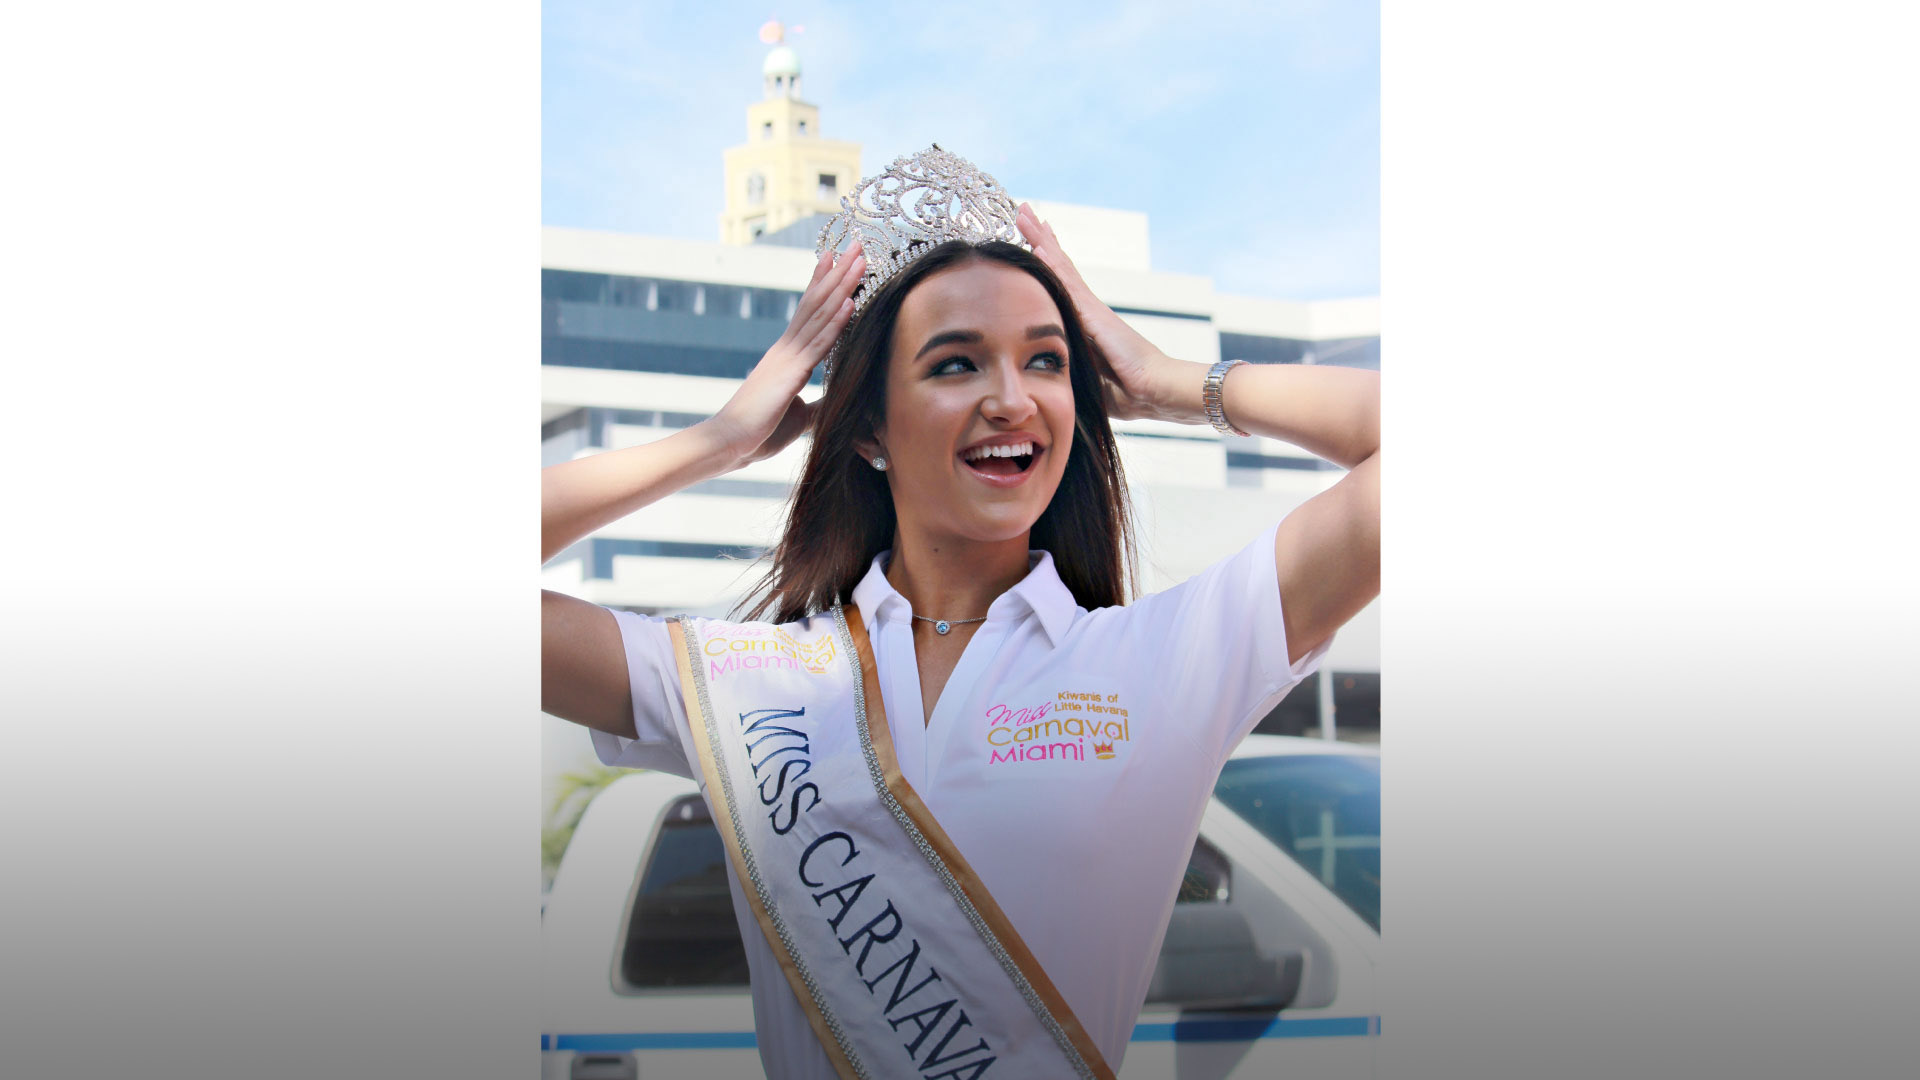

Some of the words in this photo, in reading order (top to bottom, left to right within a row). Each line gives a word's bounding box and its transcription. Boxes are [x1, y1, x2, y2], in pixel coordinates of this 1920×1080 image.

[711, 652, 799, 681] Miami
[1055, 702, 1082, 712] Little
[1087, 703, 1128, 717] Havana
[1058, 691, 1102, 702] Kiwanis
[1107, 693, 1118, 703] of
[986, 702, 1051, 726] Miss
[987, 718, 1130, 746] Carnaval
[989, 738, 1084, 765] Miami
[739, 706, 822, 835] MISS
